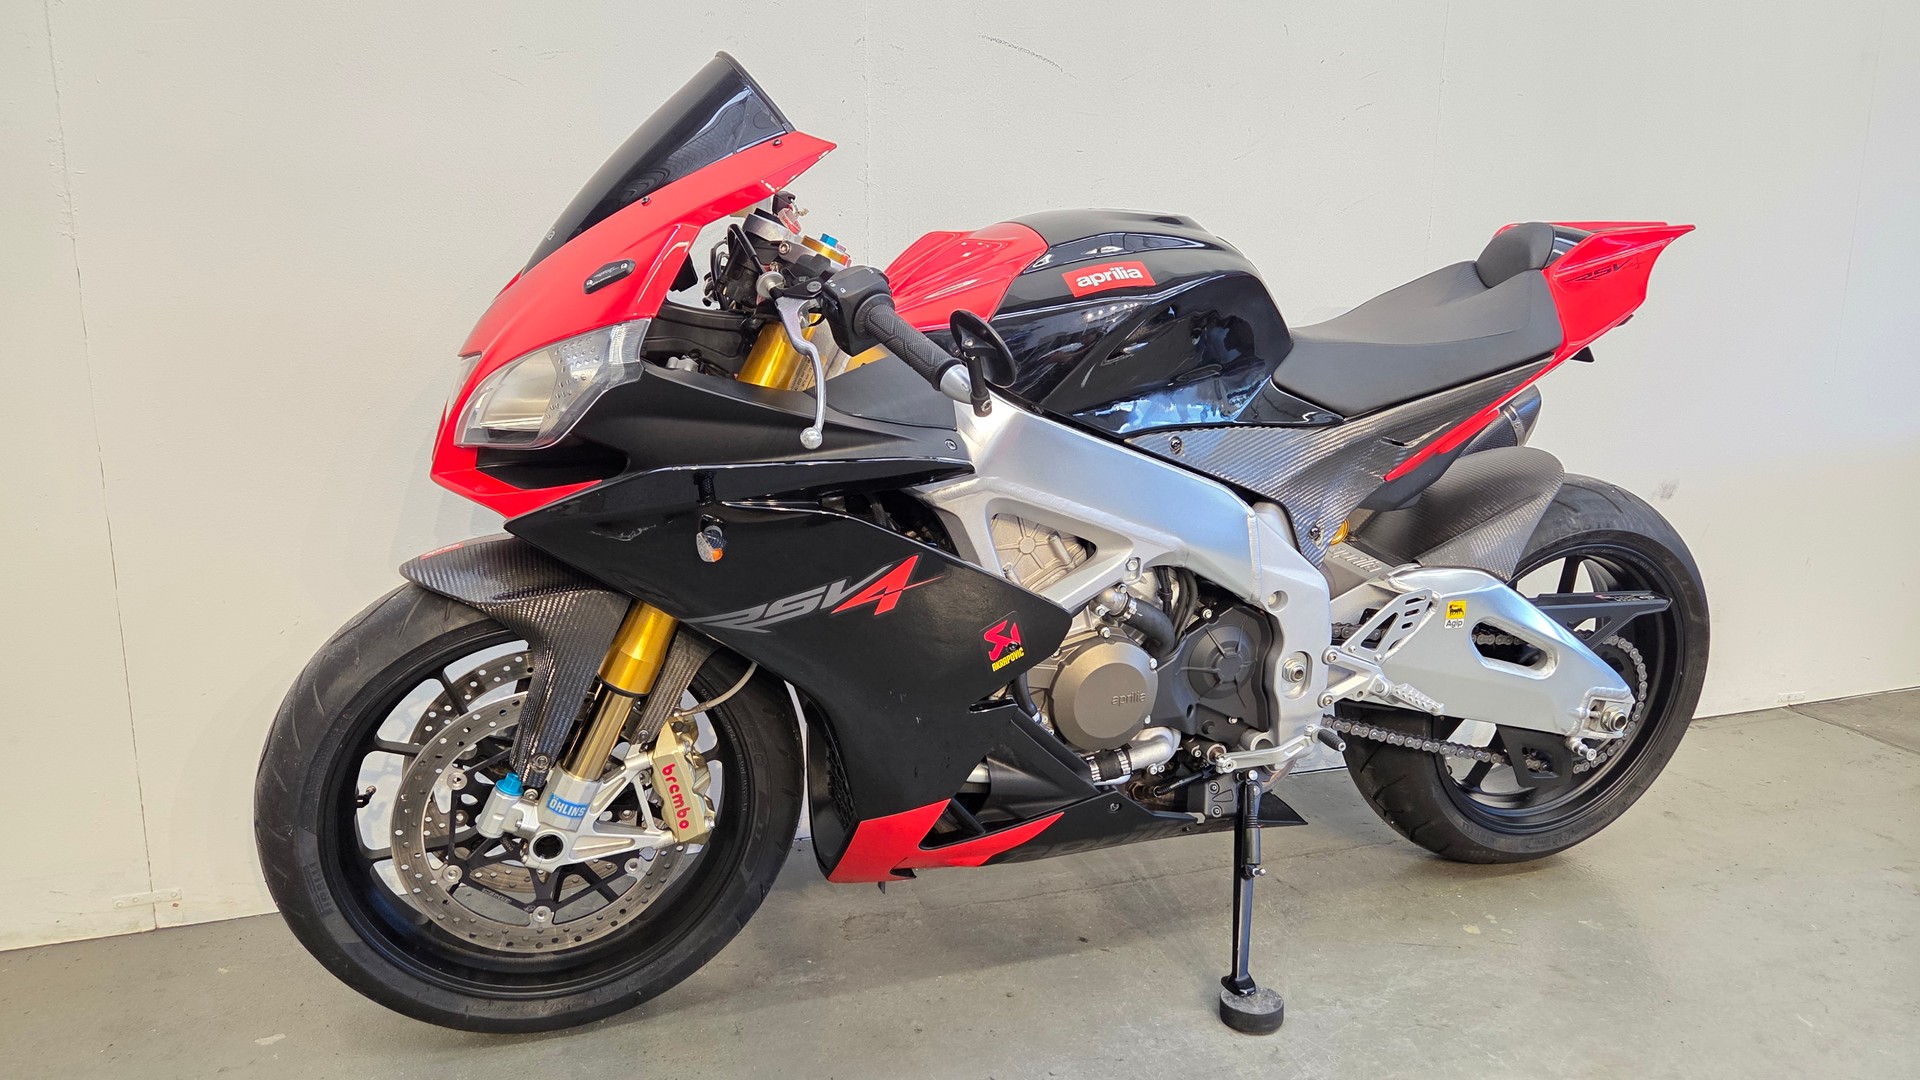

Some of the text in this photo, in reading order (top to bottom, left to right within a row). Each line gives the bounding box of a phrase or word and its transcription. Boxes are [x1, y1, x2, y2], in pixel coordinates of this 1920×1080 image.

[1076, 266, 1143, 287] aprilia
[683, 554, 945, 634] RSV4
[1111, 690, 1146, 707] aprilia
[549, 795, 586, 818] ÖHLINS
[662, 763, 691, 830] brembo
